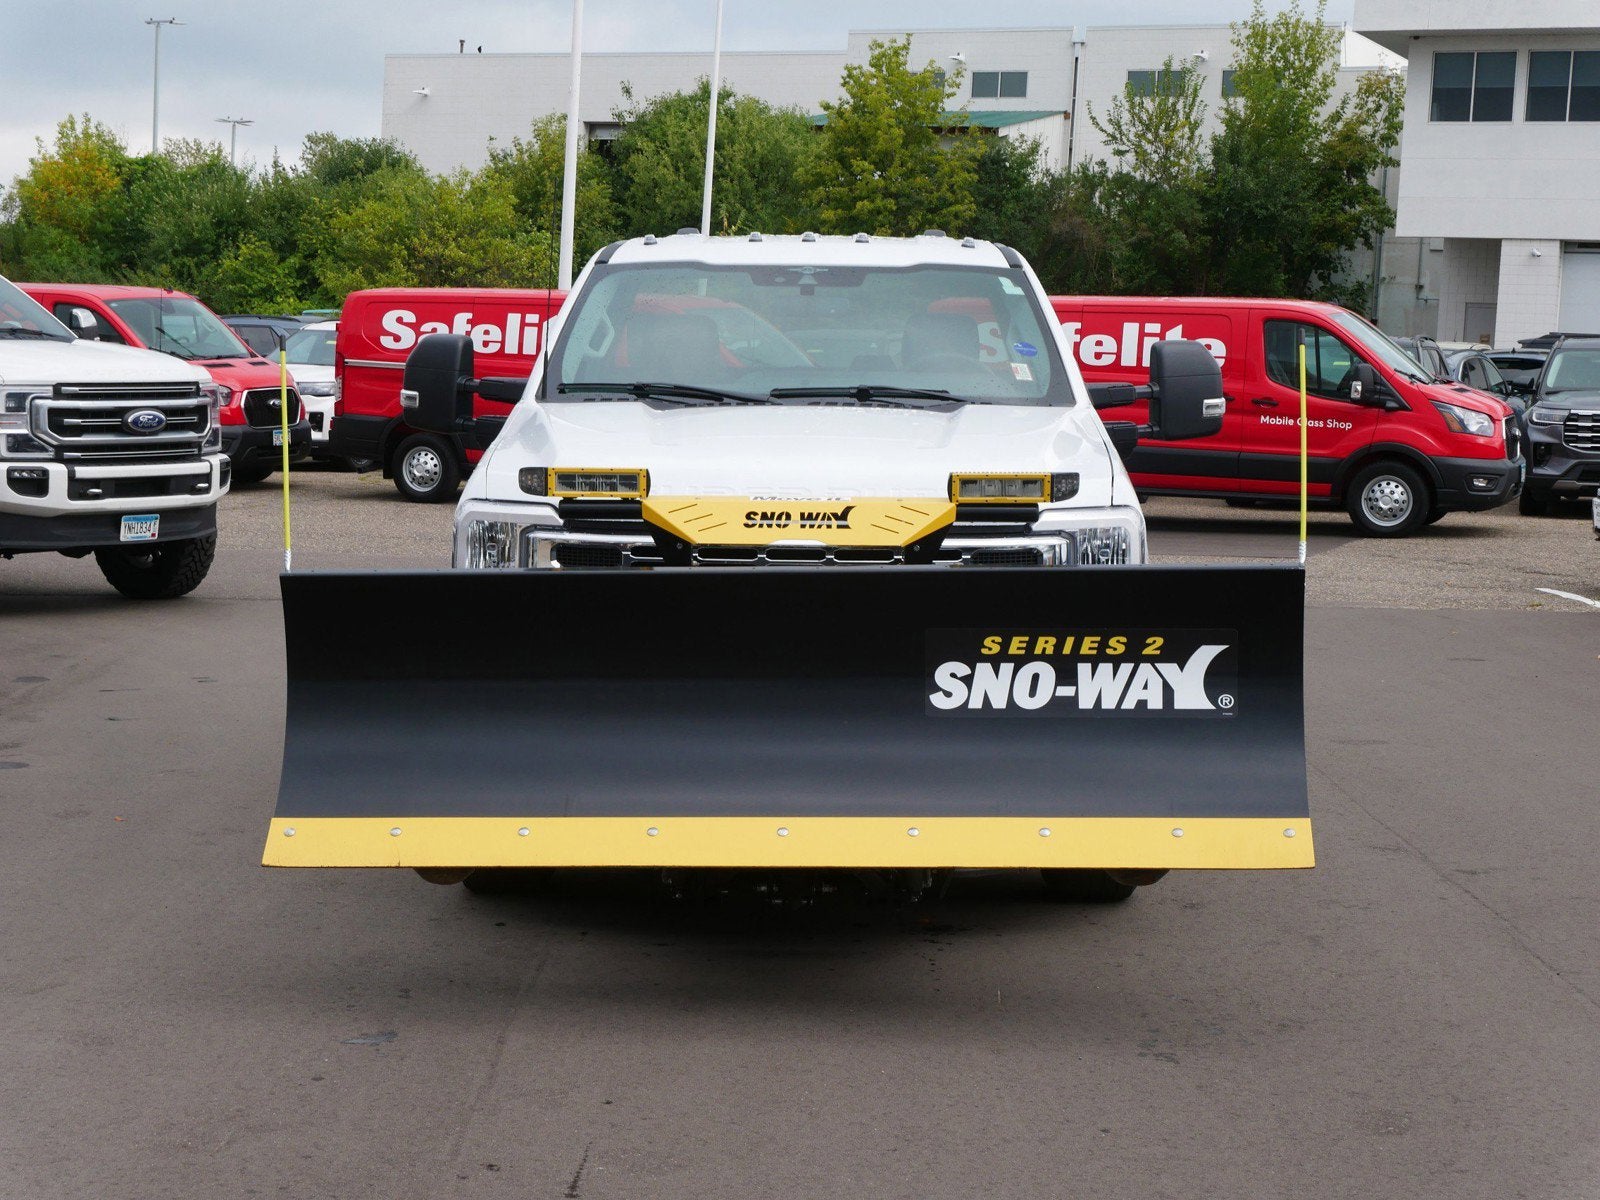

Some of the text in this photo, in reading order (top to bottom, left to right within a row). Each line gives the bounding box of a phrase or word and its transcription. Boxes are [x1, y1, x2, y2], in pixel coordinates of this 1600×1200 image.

[138, 415, 158, 427] Ford
[1260, 414, 1294, 426] Mobile
[1326, 419, 1353, 431] Shop
[743, 505, 857, 529] SNO-WAY
[980, 636, 1165, 655] SERIES 2
[929, 644, 1230, 710] SNO-WAY
